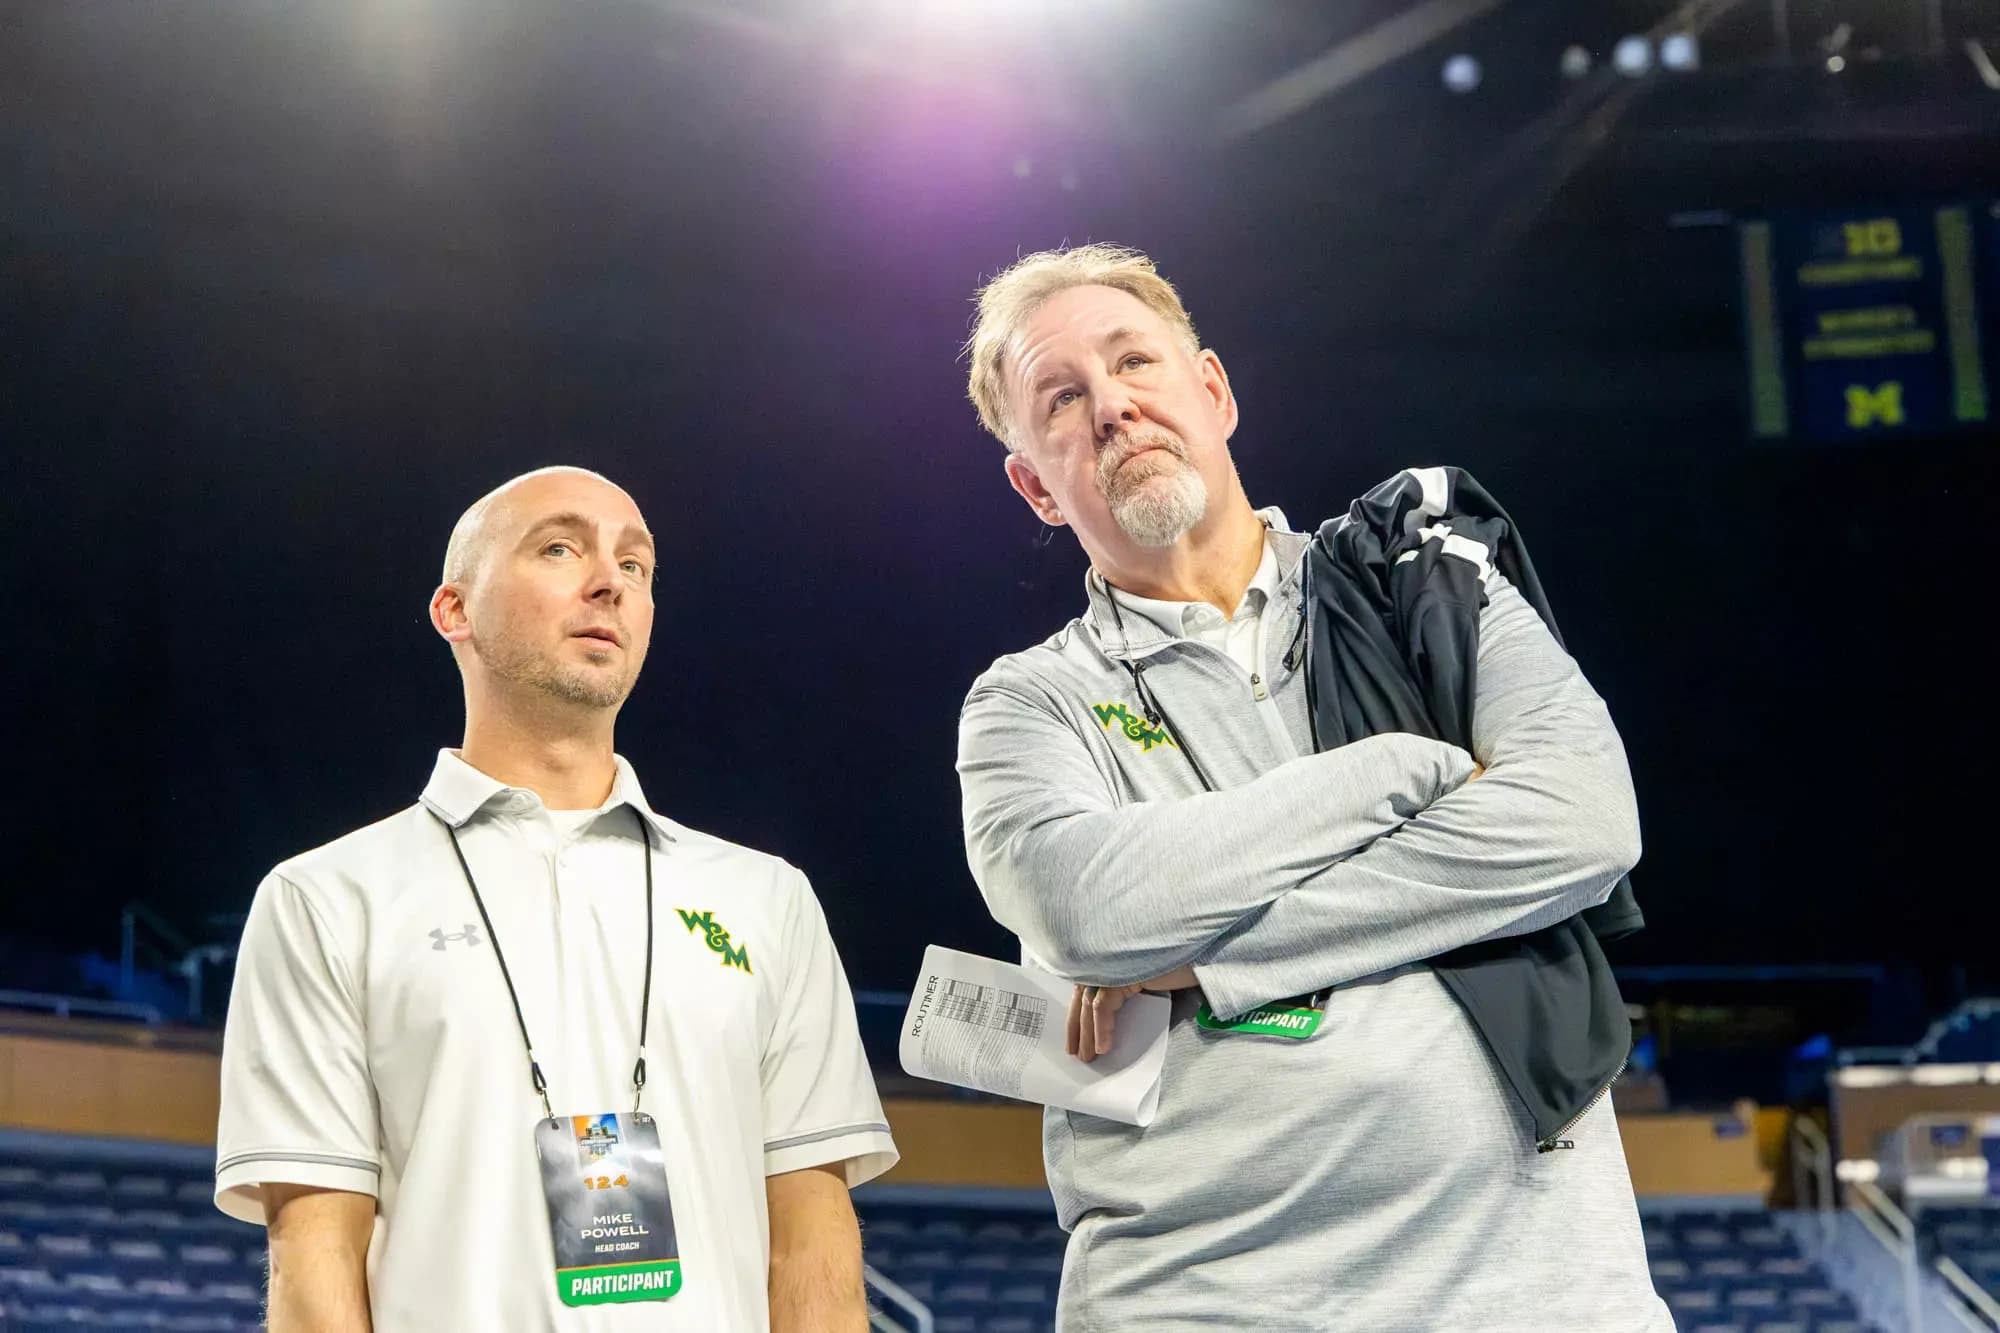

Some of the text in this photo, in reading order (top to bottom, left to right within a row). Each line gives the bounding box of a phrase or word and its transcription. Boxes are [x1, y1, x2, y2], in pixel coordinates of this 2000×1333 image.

[1845, 381, 1903, 427] M
[675, 907, 753, 975] W&M
[584, 1174, 629, 1190] 124
[592, 1213, 633, 1226] MIKE
[580, 1225, 649, 1239] POWELL
[594, 1241, 640, 1253] HEAD COACH
[571, 1270, 674, 1297] PARTICIPANT
